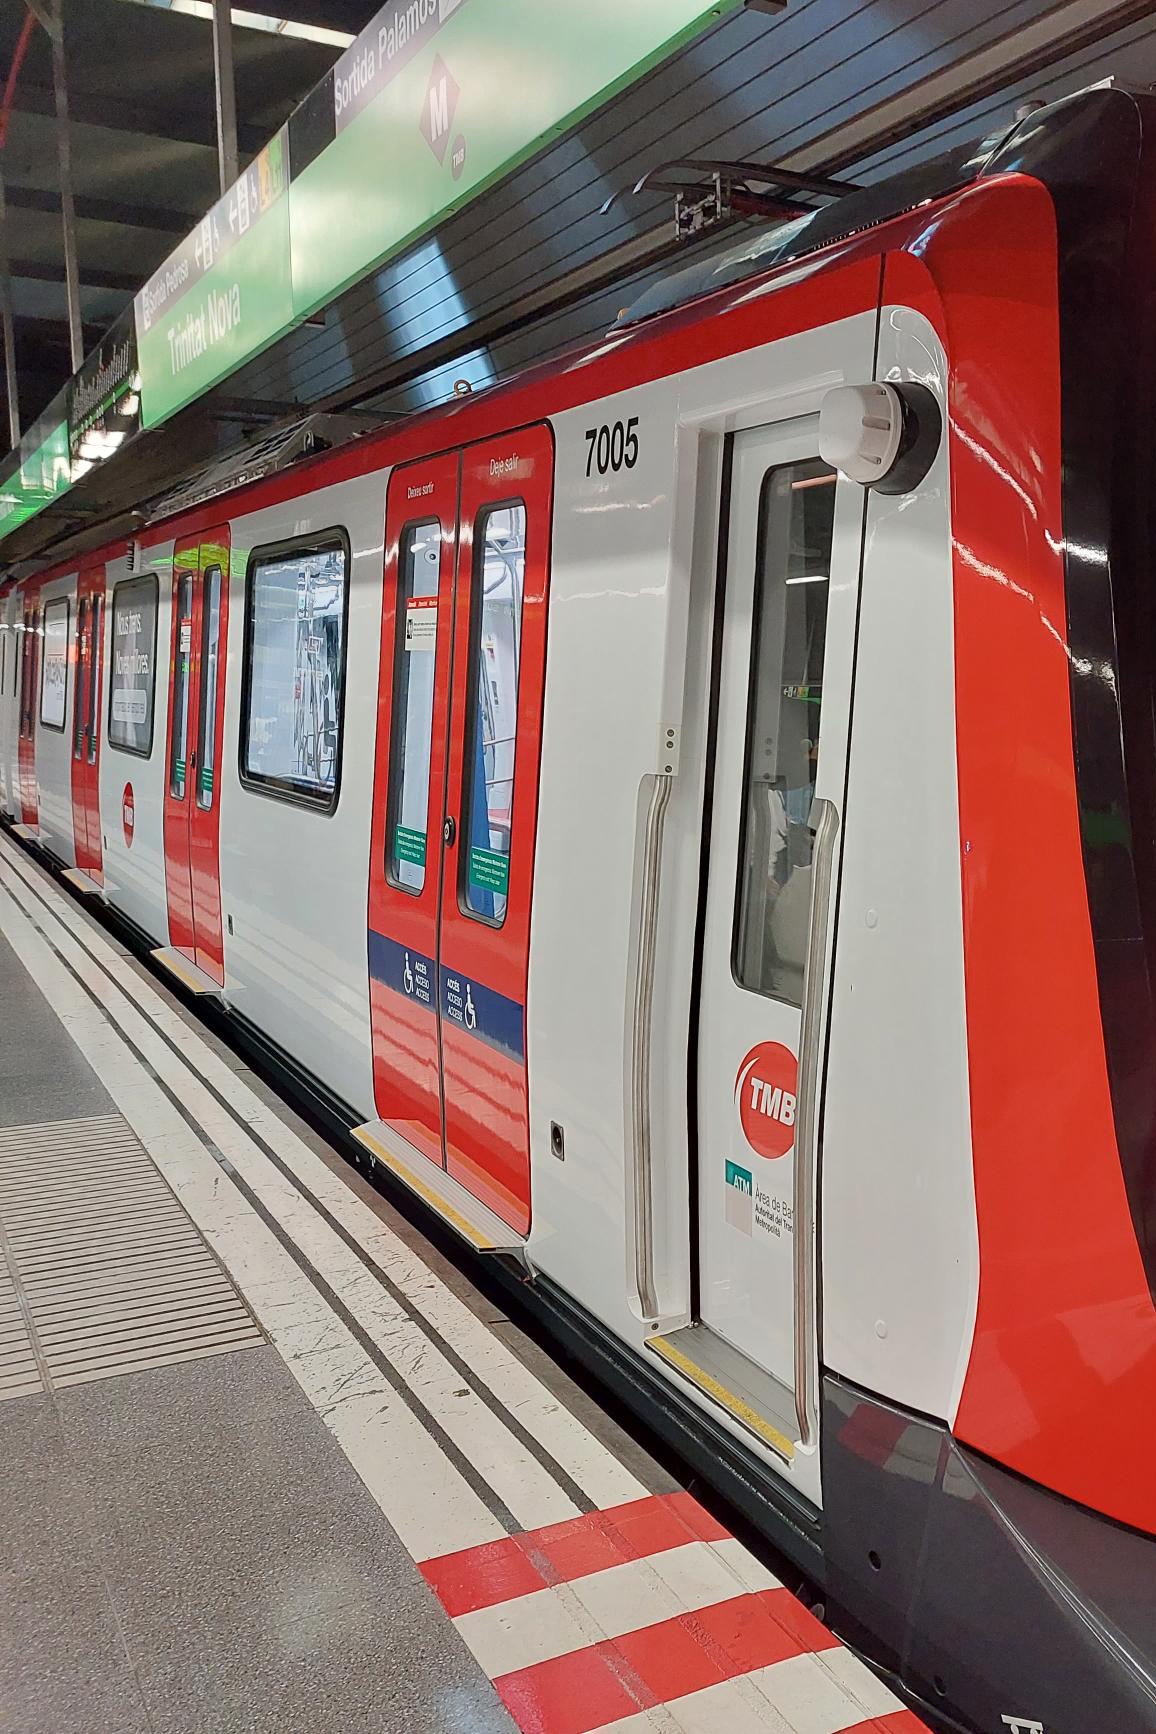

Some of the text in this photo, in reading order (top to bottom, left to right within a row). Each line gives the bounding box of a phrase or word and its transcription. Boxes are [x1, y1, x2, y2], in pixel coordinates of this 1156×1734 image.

[334, 47, 375, 116] Sortida
[430, 75, 449, 142] M
[167, 282, 241, 376] Trinitat Nova
[585, 416, 639, 478] 7005
[489, 457, 504, 479] Deje
[447, 991, 463, 1008] ACCESO
[448, 1005, 463, 1021] ACCESS
[750, 1076, 797, 1127] TMB
[733, 1174, 750, 1196] ATM
[771, 1196, 781, 1213] de
